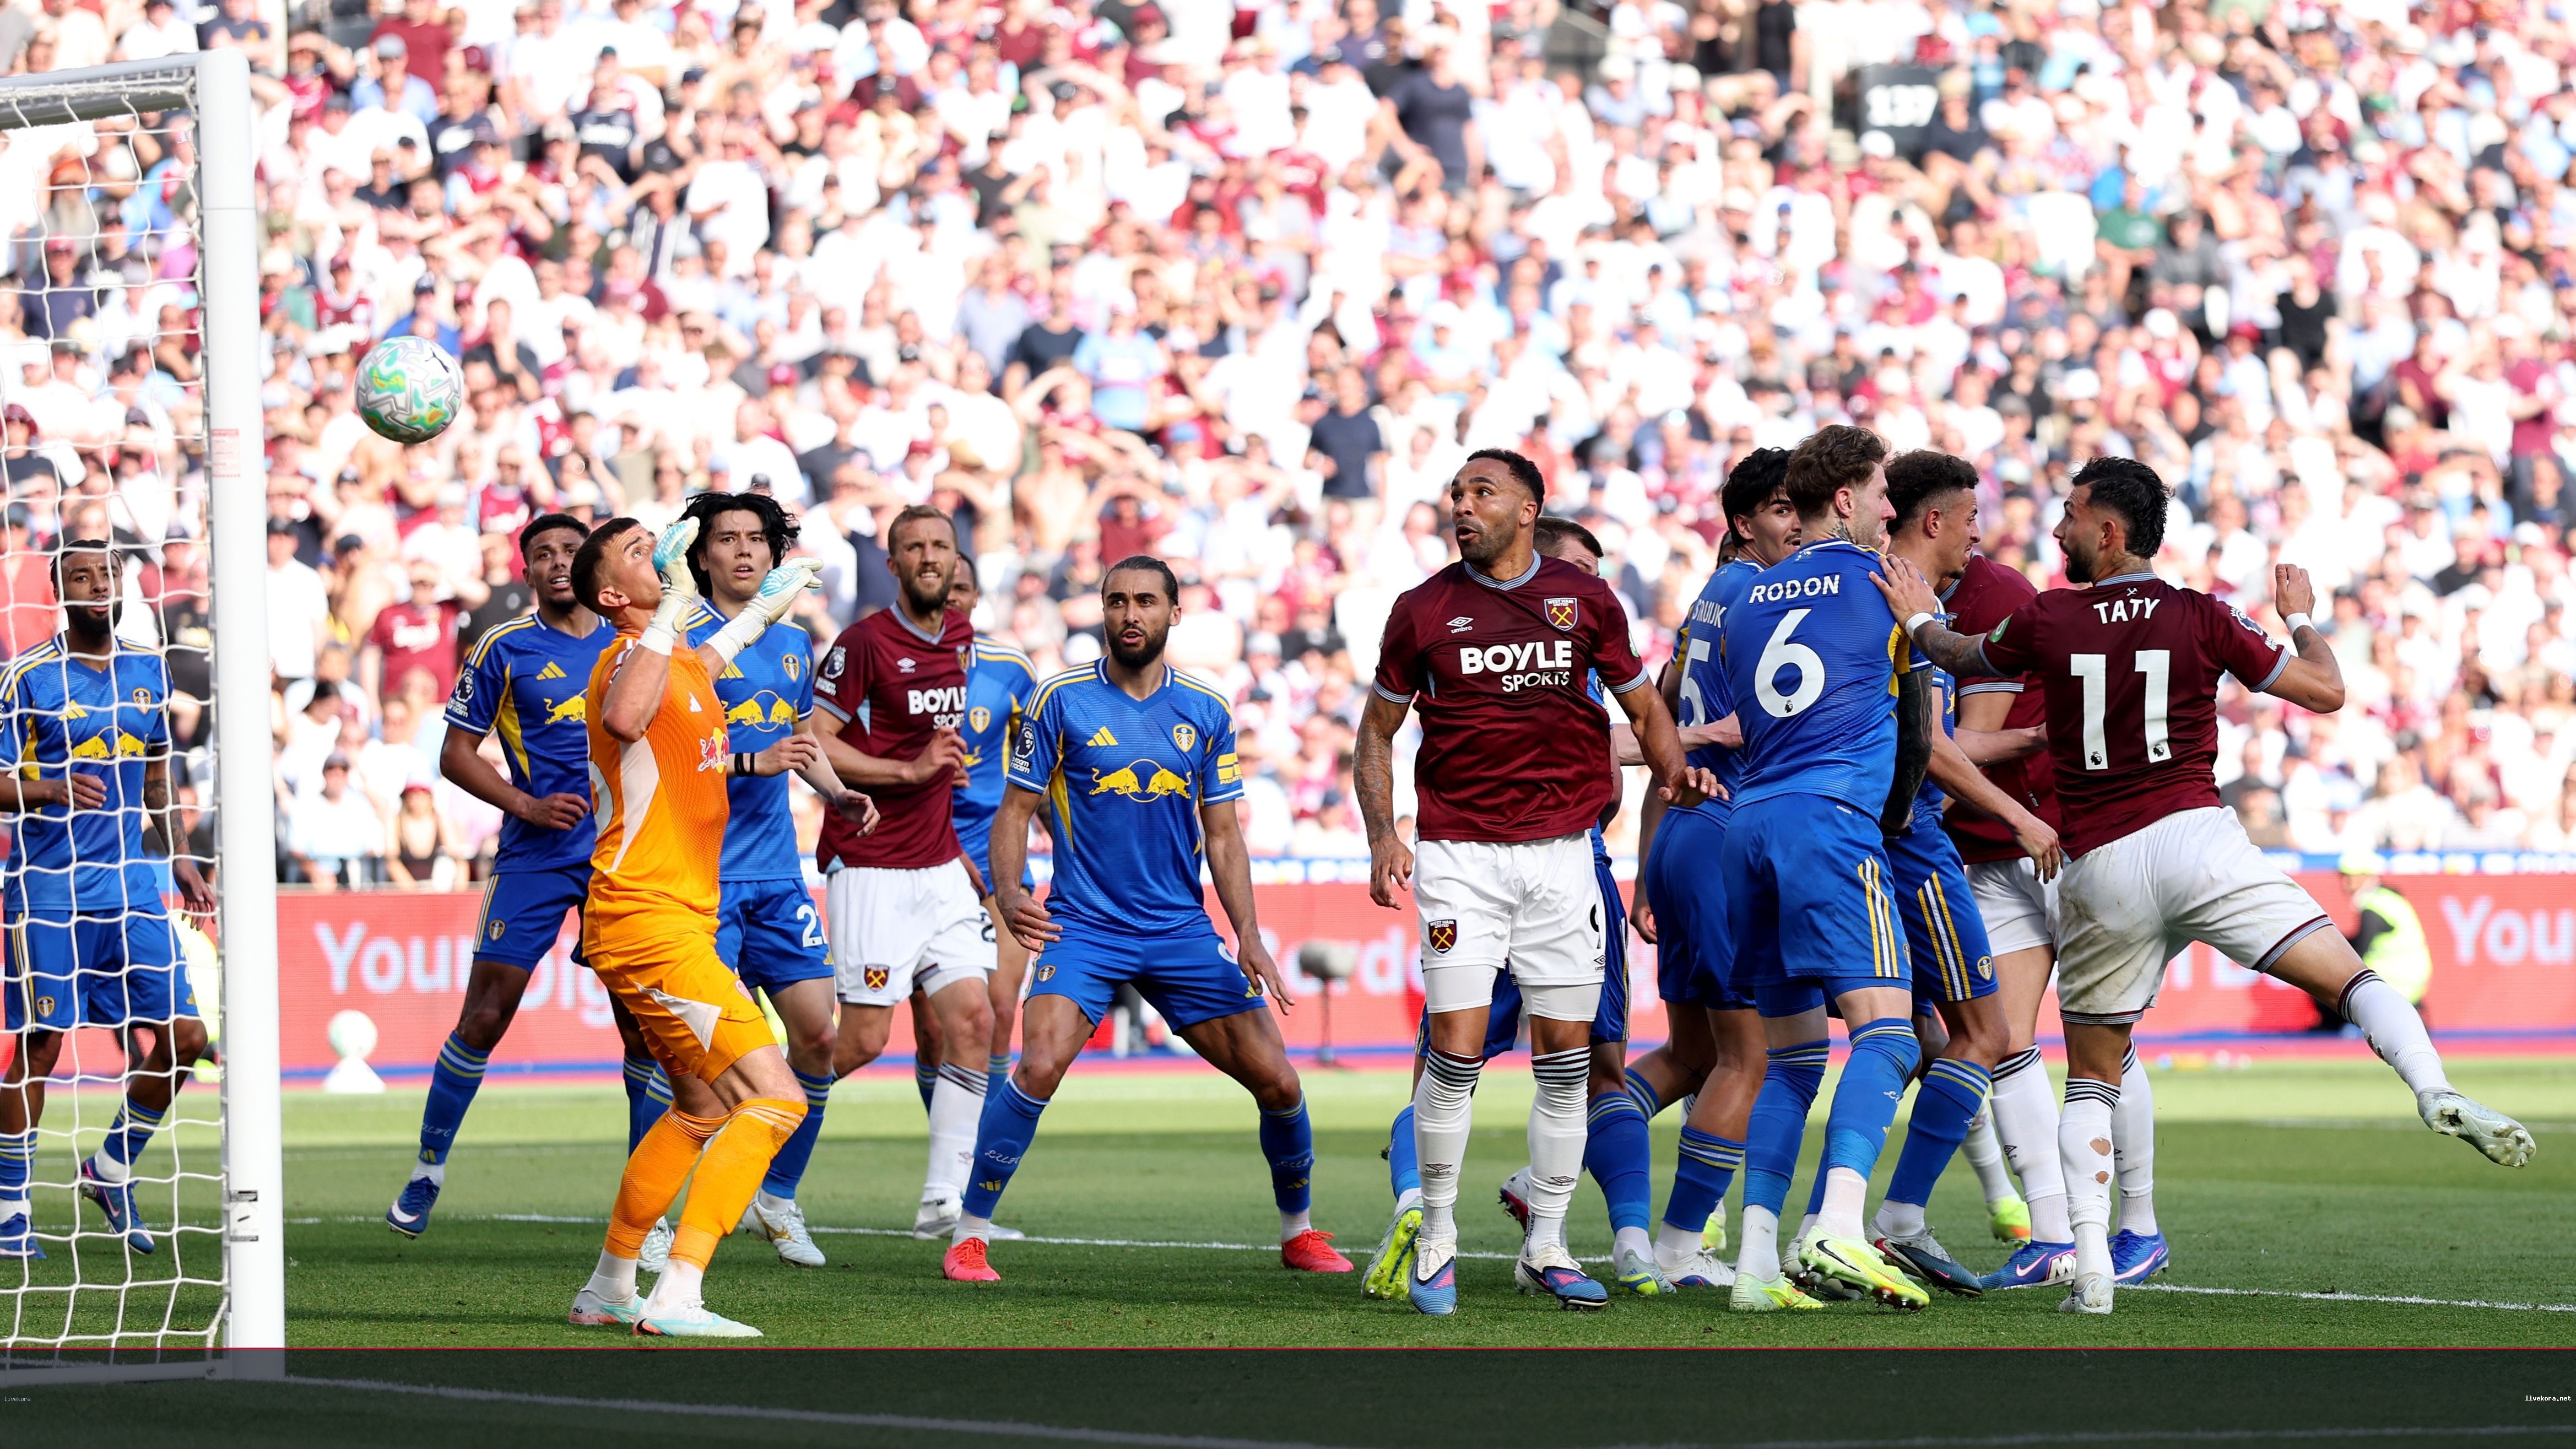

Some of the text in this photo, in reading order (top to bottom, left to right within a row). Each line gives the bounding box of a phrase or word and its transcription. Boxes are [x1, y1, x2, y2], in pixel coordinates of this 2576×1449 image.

[1749, 575, 1840, 603] RODON
[2093, 597, 2161, 624] TATY
[1460, 640, 1572, 674] BOYLE
[1755, 608, 1826, 718] 6
[1501, 671, 1570, 693] SPORTS
[1679, 638, 1711, 727] 5
[2070, 650, 2172, 770] 11
